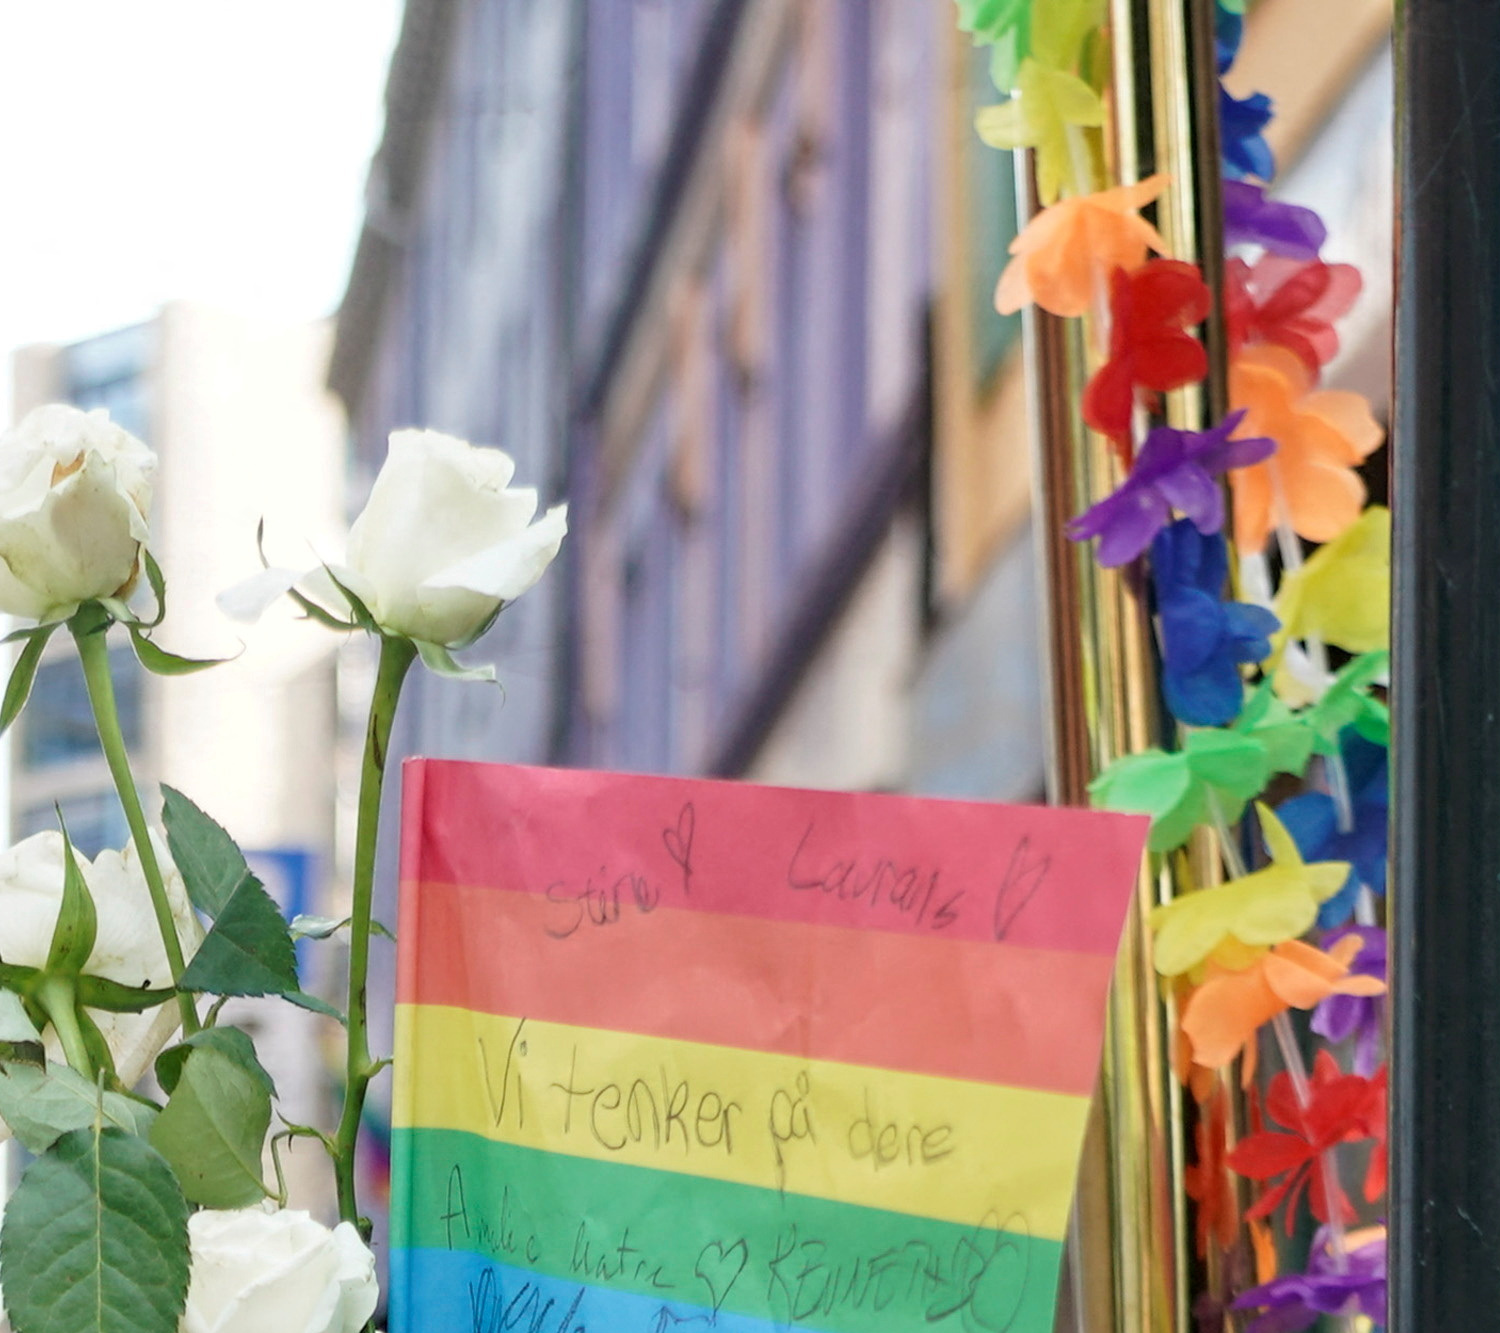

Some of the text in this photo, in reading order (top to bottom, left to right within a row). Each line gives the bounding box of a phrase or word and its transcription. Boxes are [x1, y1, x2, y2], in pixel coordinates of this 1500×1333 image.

[478, 1016, 956, 1208] Vi tenker på dere
